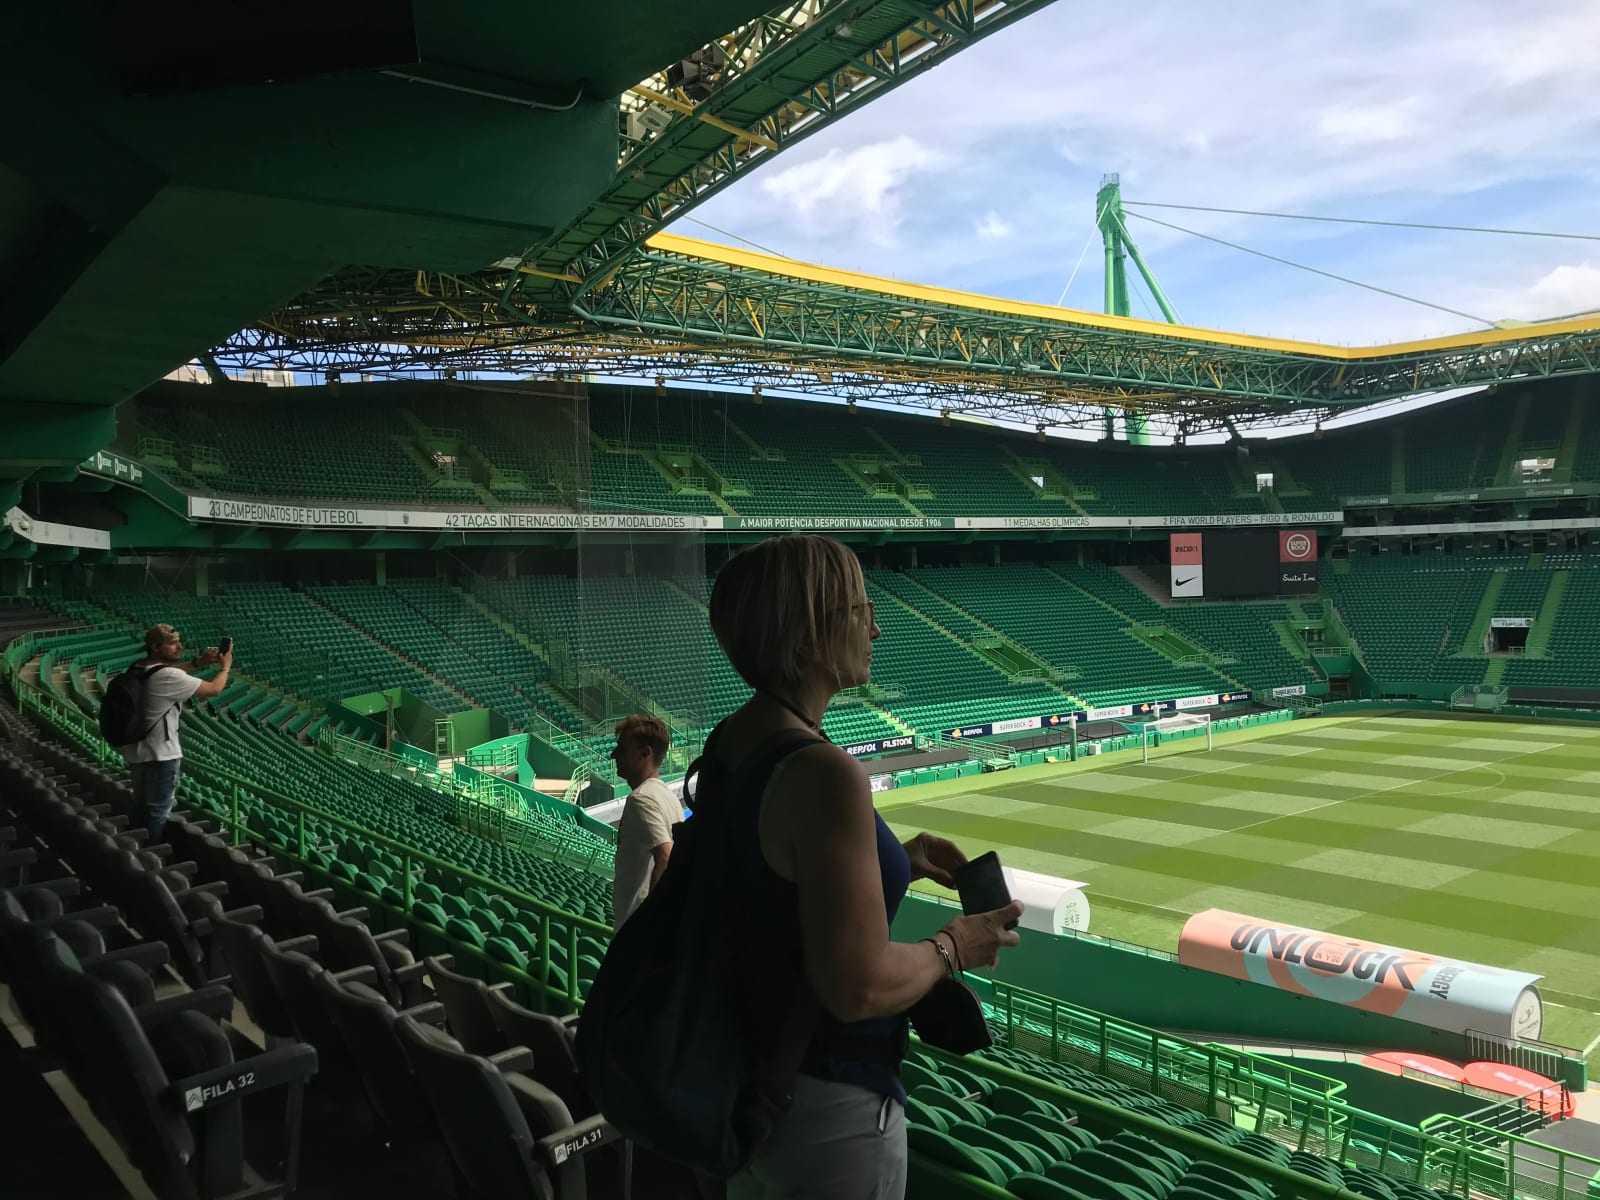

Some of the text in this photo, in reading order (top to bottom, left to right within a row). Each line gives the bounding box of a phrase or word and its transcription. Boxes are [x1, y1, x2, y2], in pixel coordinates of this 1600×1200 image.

[208, 501, 364, 524] 23 CAMPEONATOS DE FUTEBOL
[1169, 516, 1186, 525] FIFA
[1187, 516, 1215, 525] WORLD
[1216, 515, 1252, 525] PLAYERS
[1260, 514, 1281, 523] FIGO
[1291, 512, 1335, 522] RONALDO
[445, 514, 685, 528] 42 TAÇAS INTERNACIONAIS EM 7 MODALIDADES
[740, 516, 942, 528] A MAIOR POTÊNCIA DESPORTIVA NACIONAL DESDE 1906
[1013, 518, 1051, 527] MEDALHAS
[847, 743, 877, 755] REPSOL
[1231, 924, 1425, 991] UNLOCK
[202, 1072, 256, 1101] FILA 32
[566, 1128, 602, 1155] FILA 31
